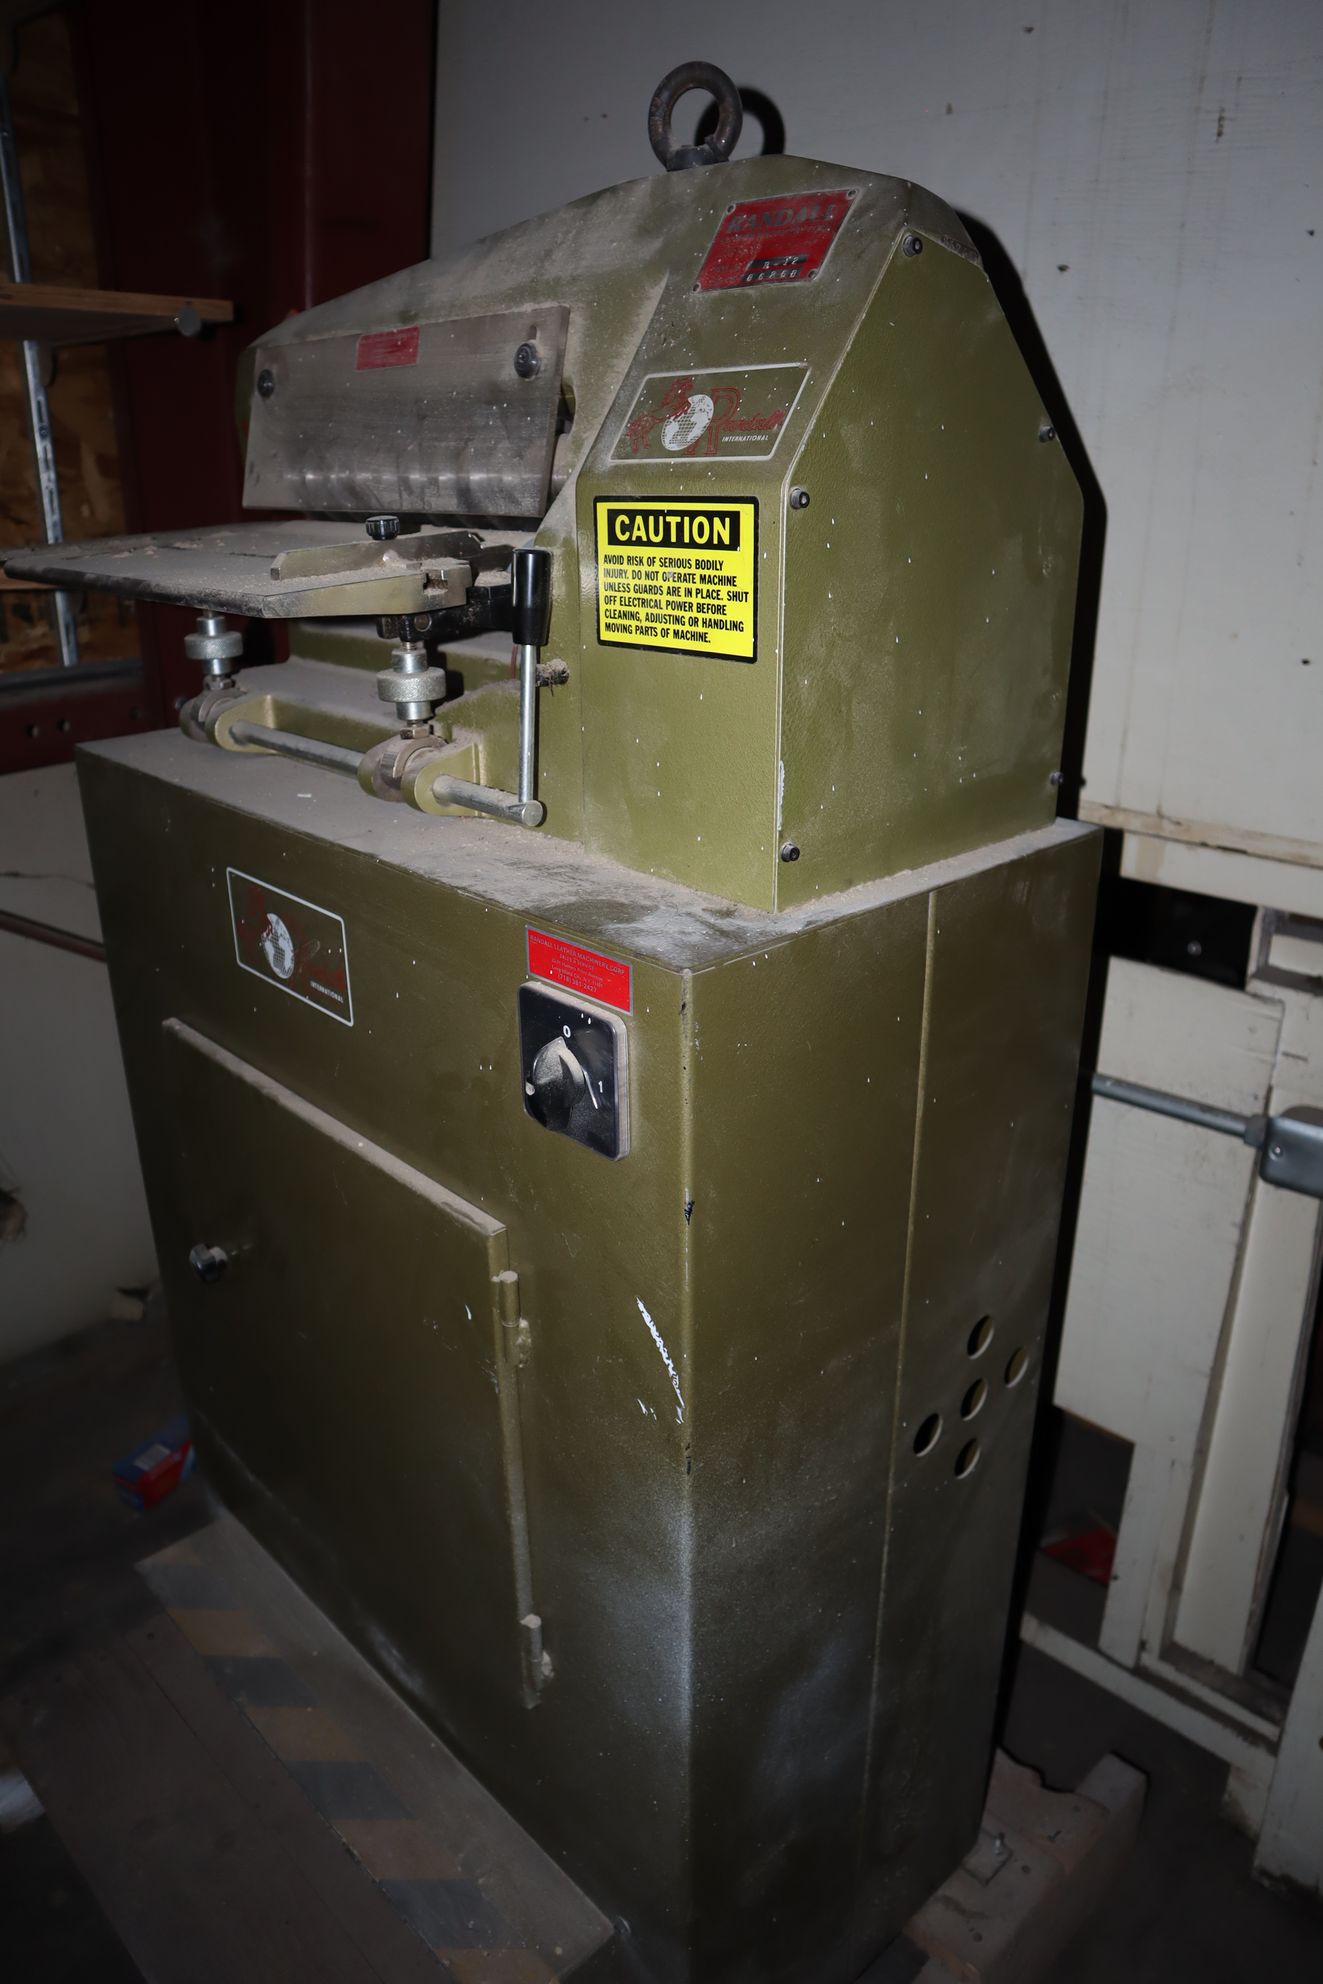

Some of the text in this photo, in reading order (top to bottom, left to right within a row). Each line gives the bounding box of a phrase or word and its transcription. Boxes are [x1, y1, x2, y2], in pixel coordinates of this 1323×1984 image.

[615, 514, 730, 545] CAUTION
[604, 554, 723, 571] AVOID RISK OF SERIOUS BODILY
[604, 568, 737, 587] INJURY. DO NOT OPERATE MACHINE
[604, 582, 749, 603] UNLESS GUARDS ARE IN PLACE. SHUT
[604, 596, 727, 616] OFF ELECTRICAL POWER BEFORE
[604, 609, 744, 632] CLEANING, ADJUSTING OR HANDLING
[605, 622, 711, 643] MOVING PARTS OF MACHINE.
[310, 980, 344, 1004] INTERNATIONAL
[563, 1025, 571, 1038] 0
[598, 1080, 603, 1093] 1
